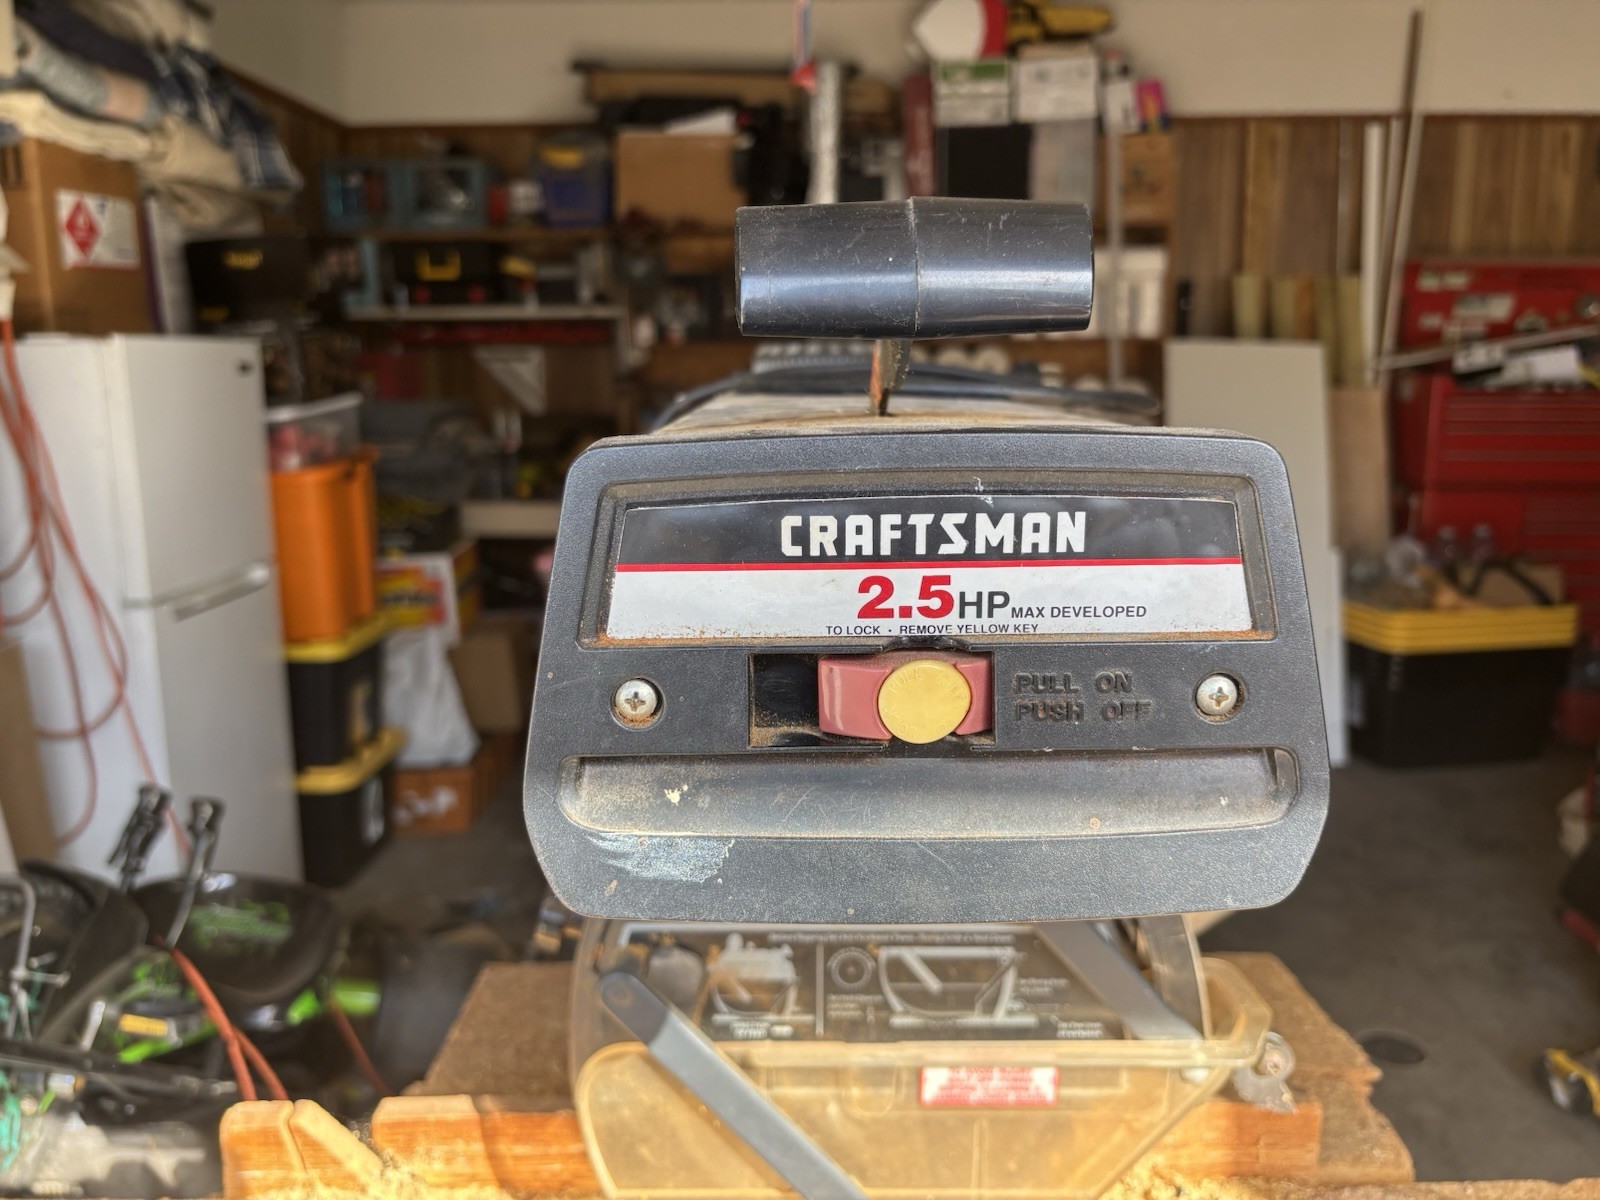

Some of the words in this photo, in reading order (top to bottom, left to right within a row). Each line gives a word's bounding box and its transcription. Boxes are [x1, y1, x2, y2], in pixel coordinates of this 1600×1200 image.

[781, 511, 1086, 557] CRAFTSMAN
[1011, 606, 1045, 618] MAX
[1050, 605, 1147, 618] DEVELOPED
[826, 625, 842, 635] TO
[848, 625, 880, 635] LOCK
[899, 625, 952, 634] REMOVE
[957, 624, 1009, 634] YELLOW
[1013, 624, 1039, 633] KEY
[1013, 672, 1080, 694] PULL
[1095, 670, 1133, 694] ON
[1013, 700, 1085, 721] PUSH
[1101, 700, 1152, 721] OFF
